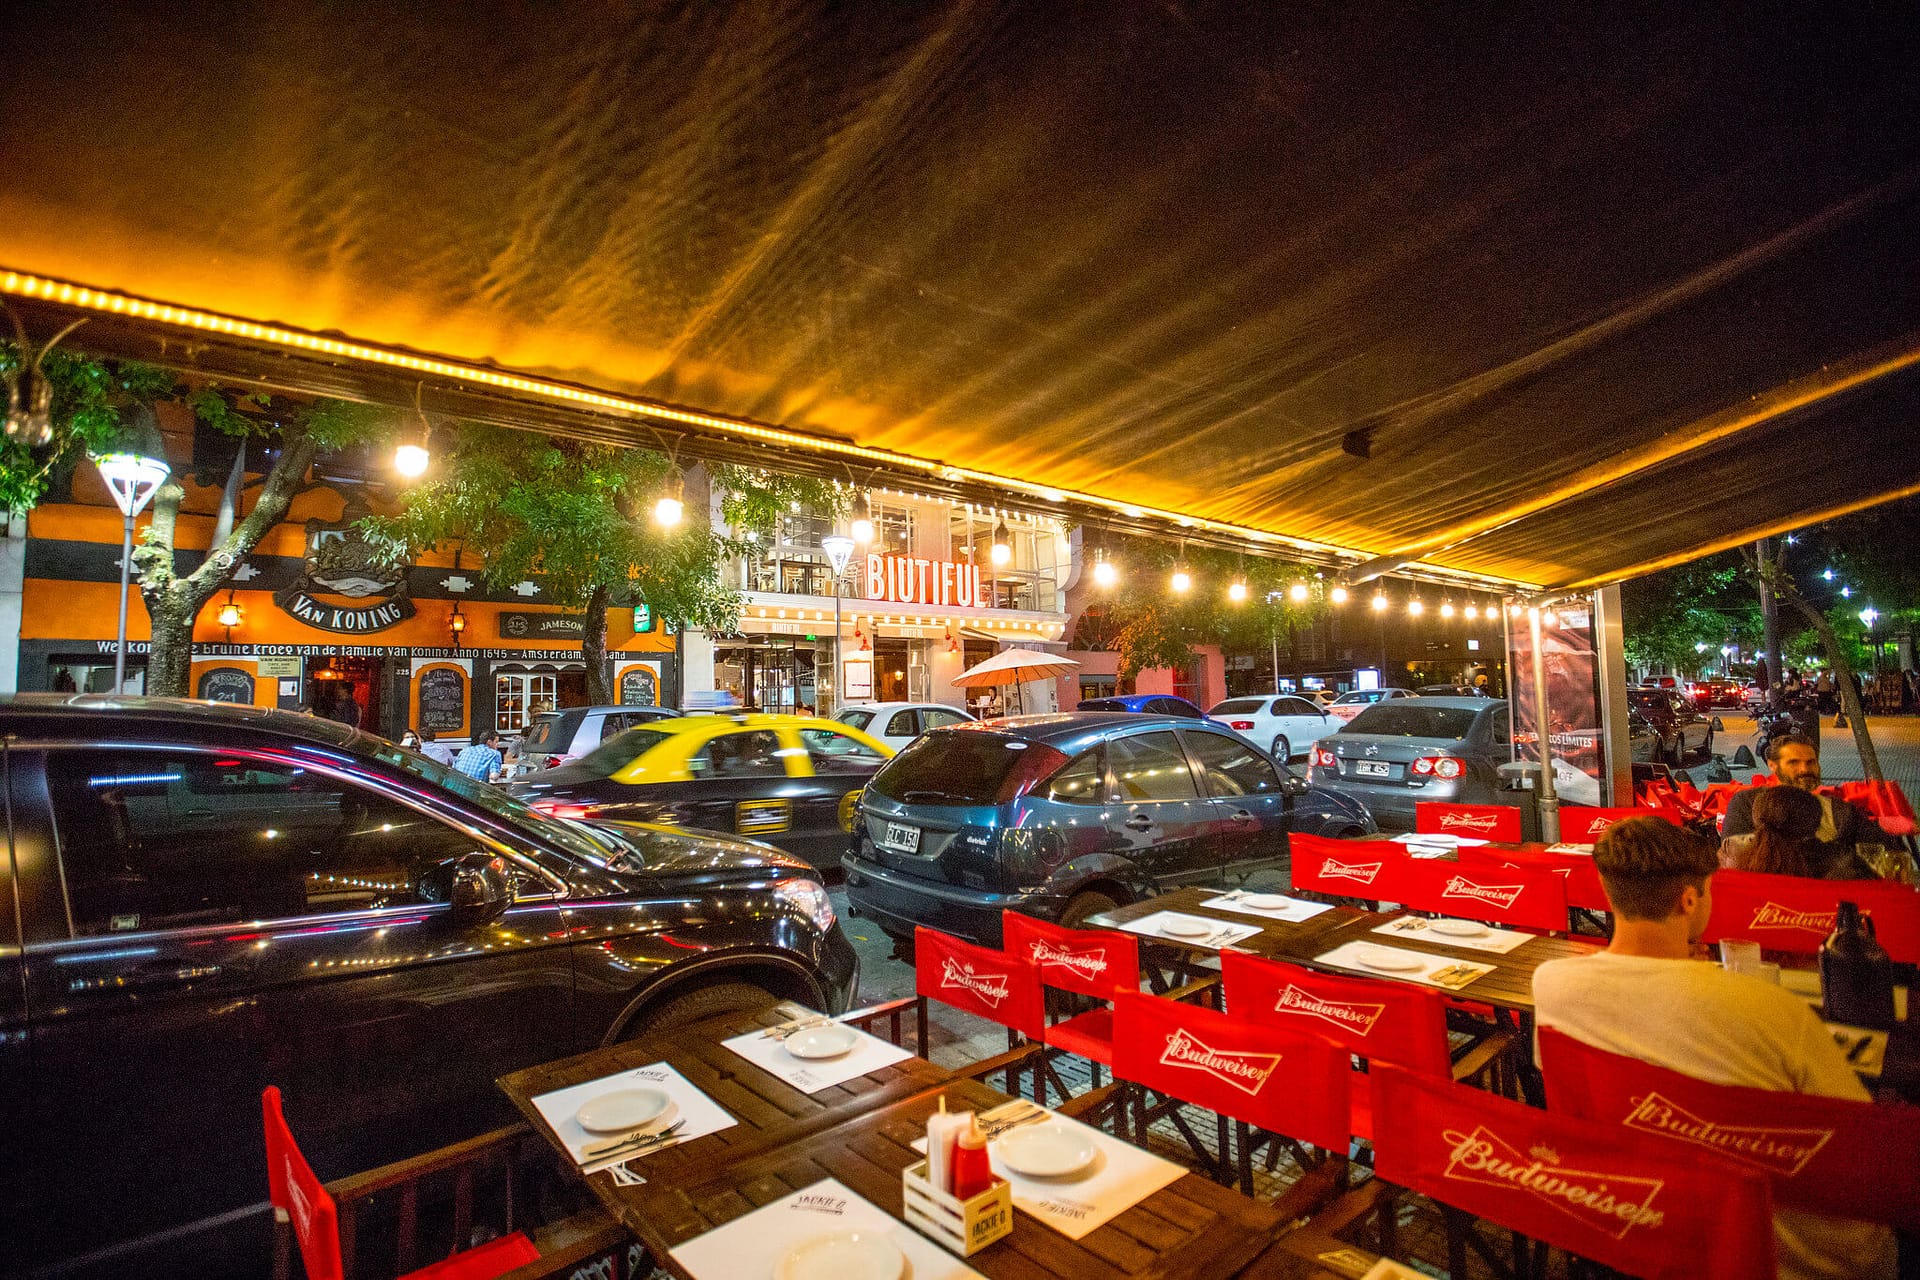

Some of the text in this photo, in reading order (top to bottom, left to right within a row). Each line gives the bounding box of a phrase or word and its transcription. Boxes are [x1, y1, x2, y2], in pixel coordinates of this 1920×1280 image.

[867, 553, 987, 608] BIUTIFUL
[332, 602, 400, 630] KONING
[540, 620, 584, 632] JAMESON
[97, 641, 152, 653] Weko
[322, 645, 336, 656] de
[482, 649, 507, 659] 1645
[1562, 733, 1592, 748] LÍMITES
[1440, 814, 1497, 829] Budweiser
[1323, 860, 1376, 878] Budweiser
[1447, 878, 1515, 902] Budweiser
[1754, 906, 1836, 930] Budwei
[1030, 942, 1107, 972] Budweiser
[942, 961, 1008, 999] Budweiser
[1279, 987, 1376, 1025] Budweiser
[1166, 1034, 1270, 1081] Budweiser
[1630, 1095, 1814, 1161] Budweiser
[1442, 1130, 1665, 1228] Budweiser
